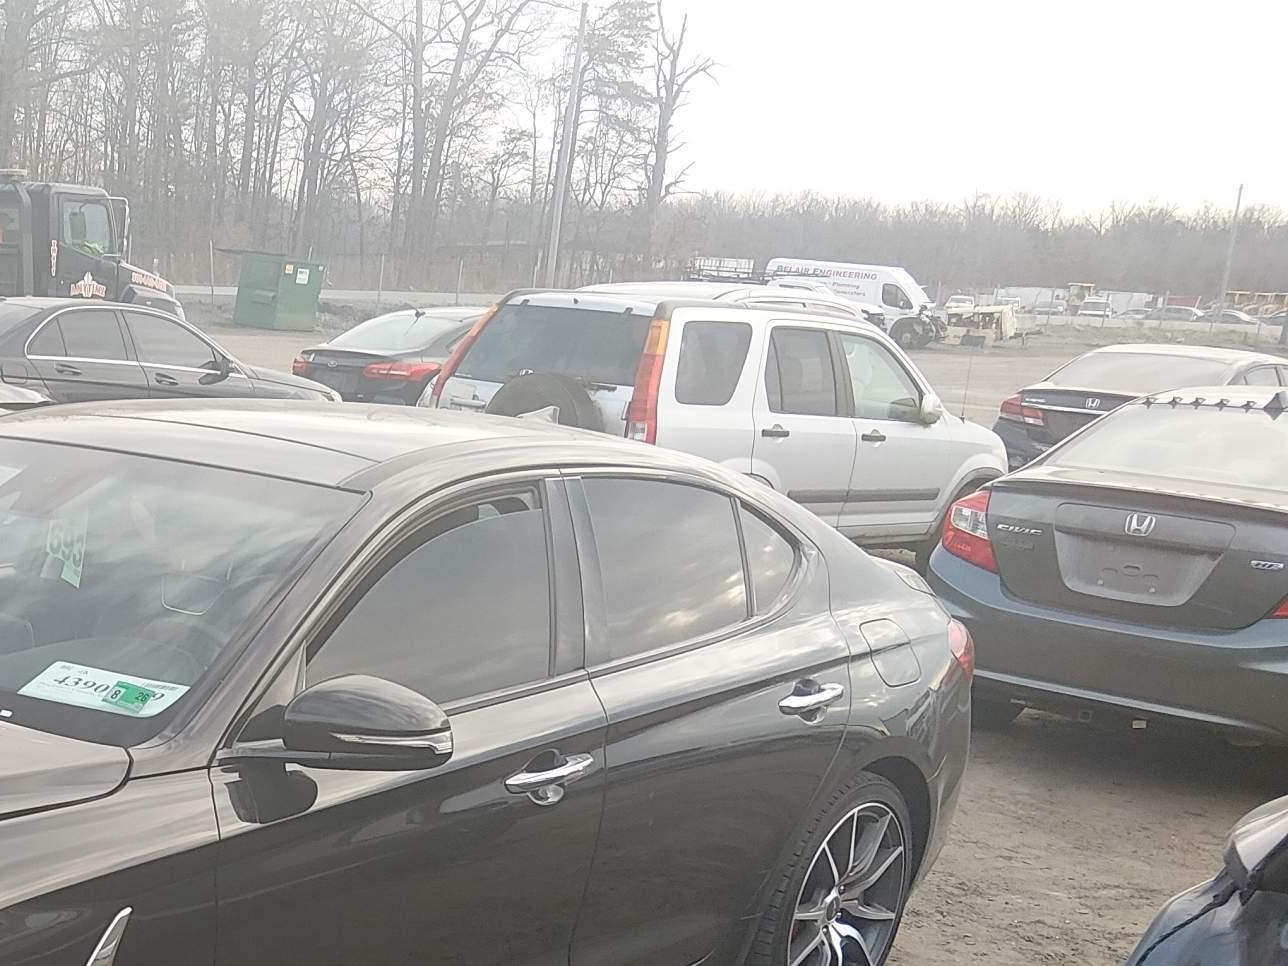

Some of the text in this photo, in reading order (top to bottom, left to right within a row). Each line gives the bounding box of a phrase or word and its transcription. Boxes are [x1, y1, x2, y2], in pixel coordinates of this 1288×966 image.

[813, 267, 878, 281] ENGINEERING
[996, 523, 1043, 536] CIVIC
[110, 688, 121, 700] 8
